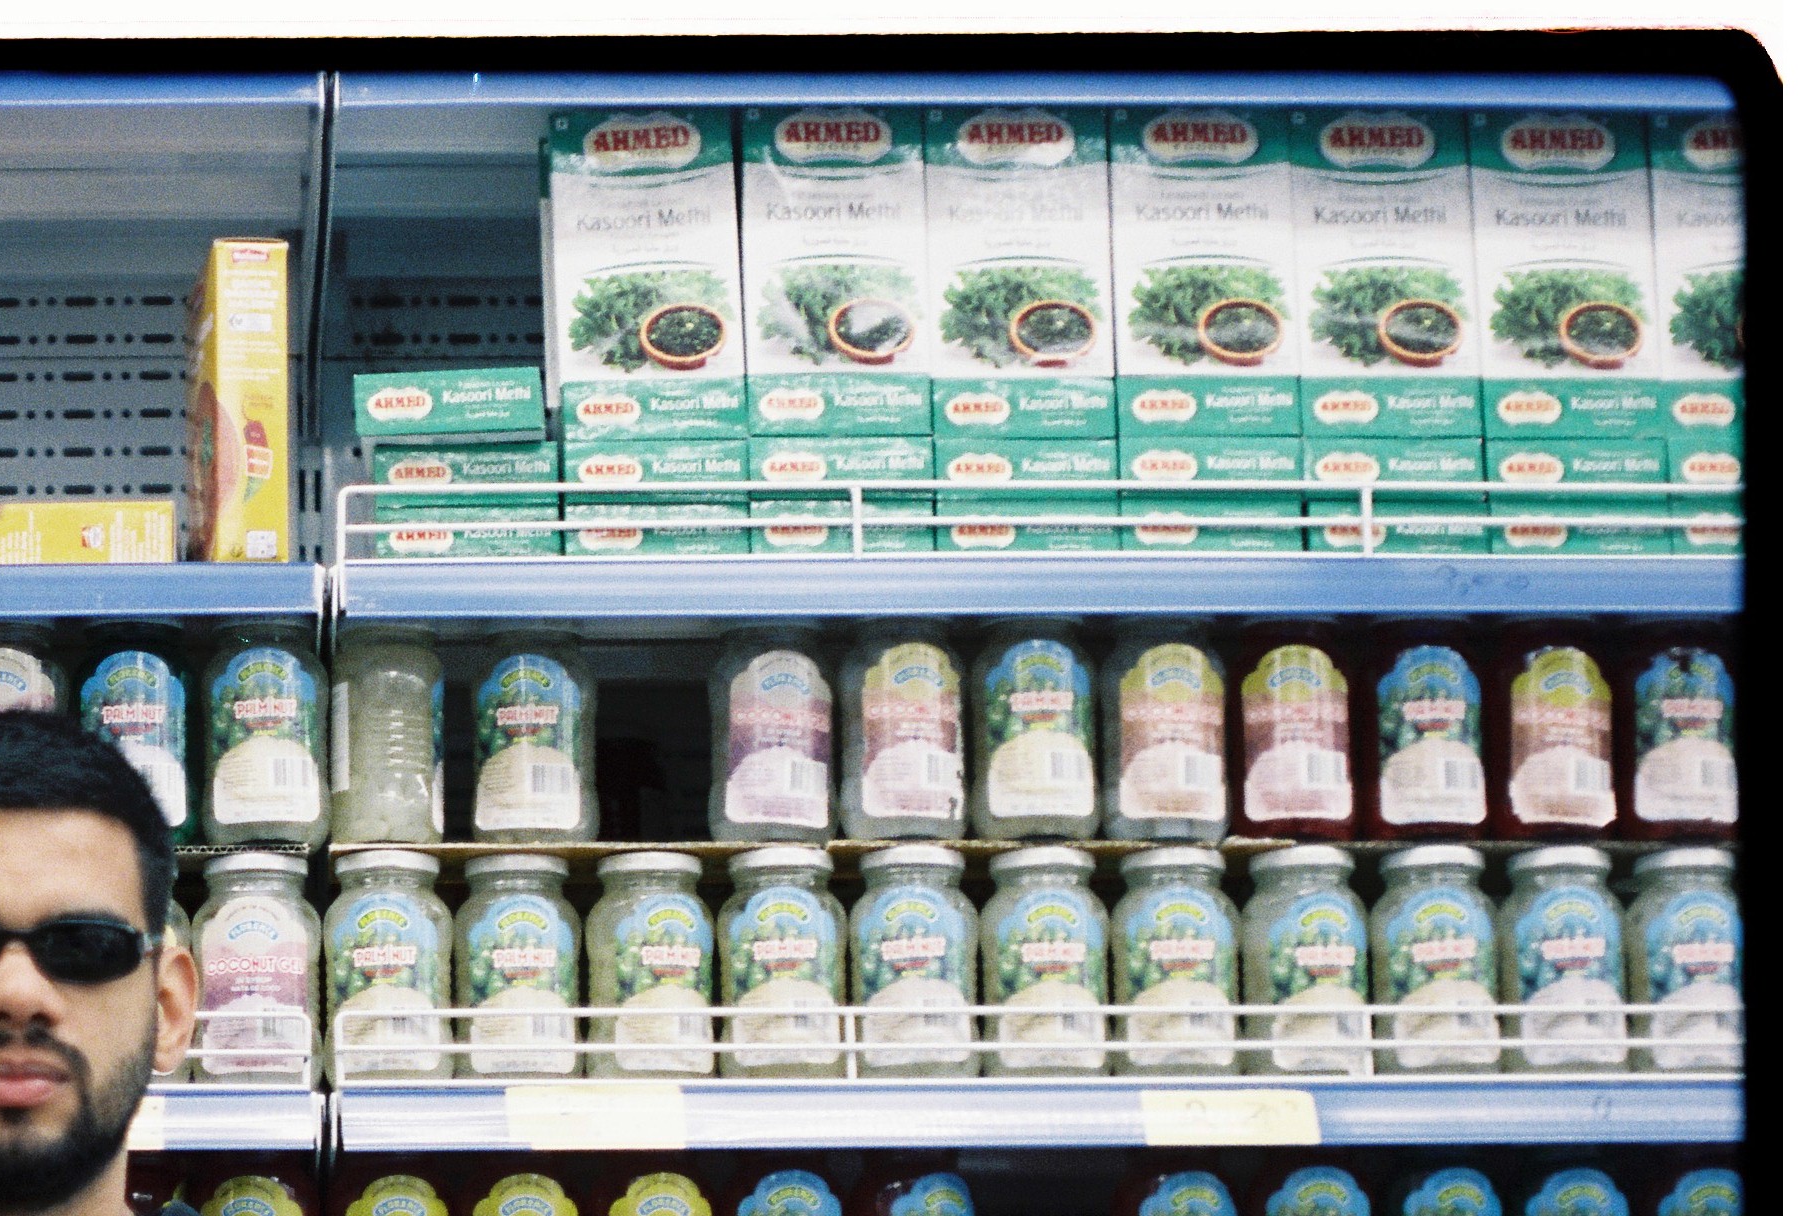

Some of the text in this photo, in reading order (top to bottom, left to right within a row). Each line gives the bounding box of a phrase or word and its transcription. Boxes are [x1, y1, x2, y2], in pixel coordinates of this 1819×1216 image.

[593, 125, 690, 152] AHMED
[785, 122, 881, 143] AHMED
[967, 123, 1064, 144] AHMED
[1152, 123, 1247, 143] AHMED
[1330, 126, 1425, 149] AHMED
[1511, 128, 1604, 150] AHMED
[766, 203, 901, 222] Kasoori Methi
[1136, 203, 1268, 222] Kasoori Methi
[1314, 206, 1447, 226] Kasoori Methi
[1496, 208, 1627, 227] Kasoori Methi
[374, 387, 531, 410] AHMED Kasoori Methi
[583, 402, 634, 416] AHMED
[651, 397, 699, 411] Kasoori
[394, 467, 446, 479] AHMED
[585, 464, 635, 476] AHMED
[103, 705, 163, 724] PALM NUT
[206, 955, 304, 975] COCONUT GEL
